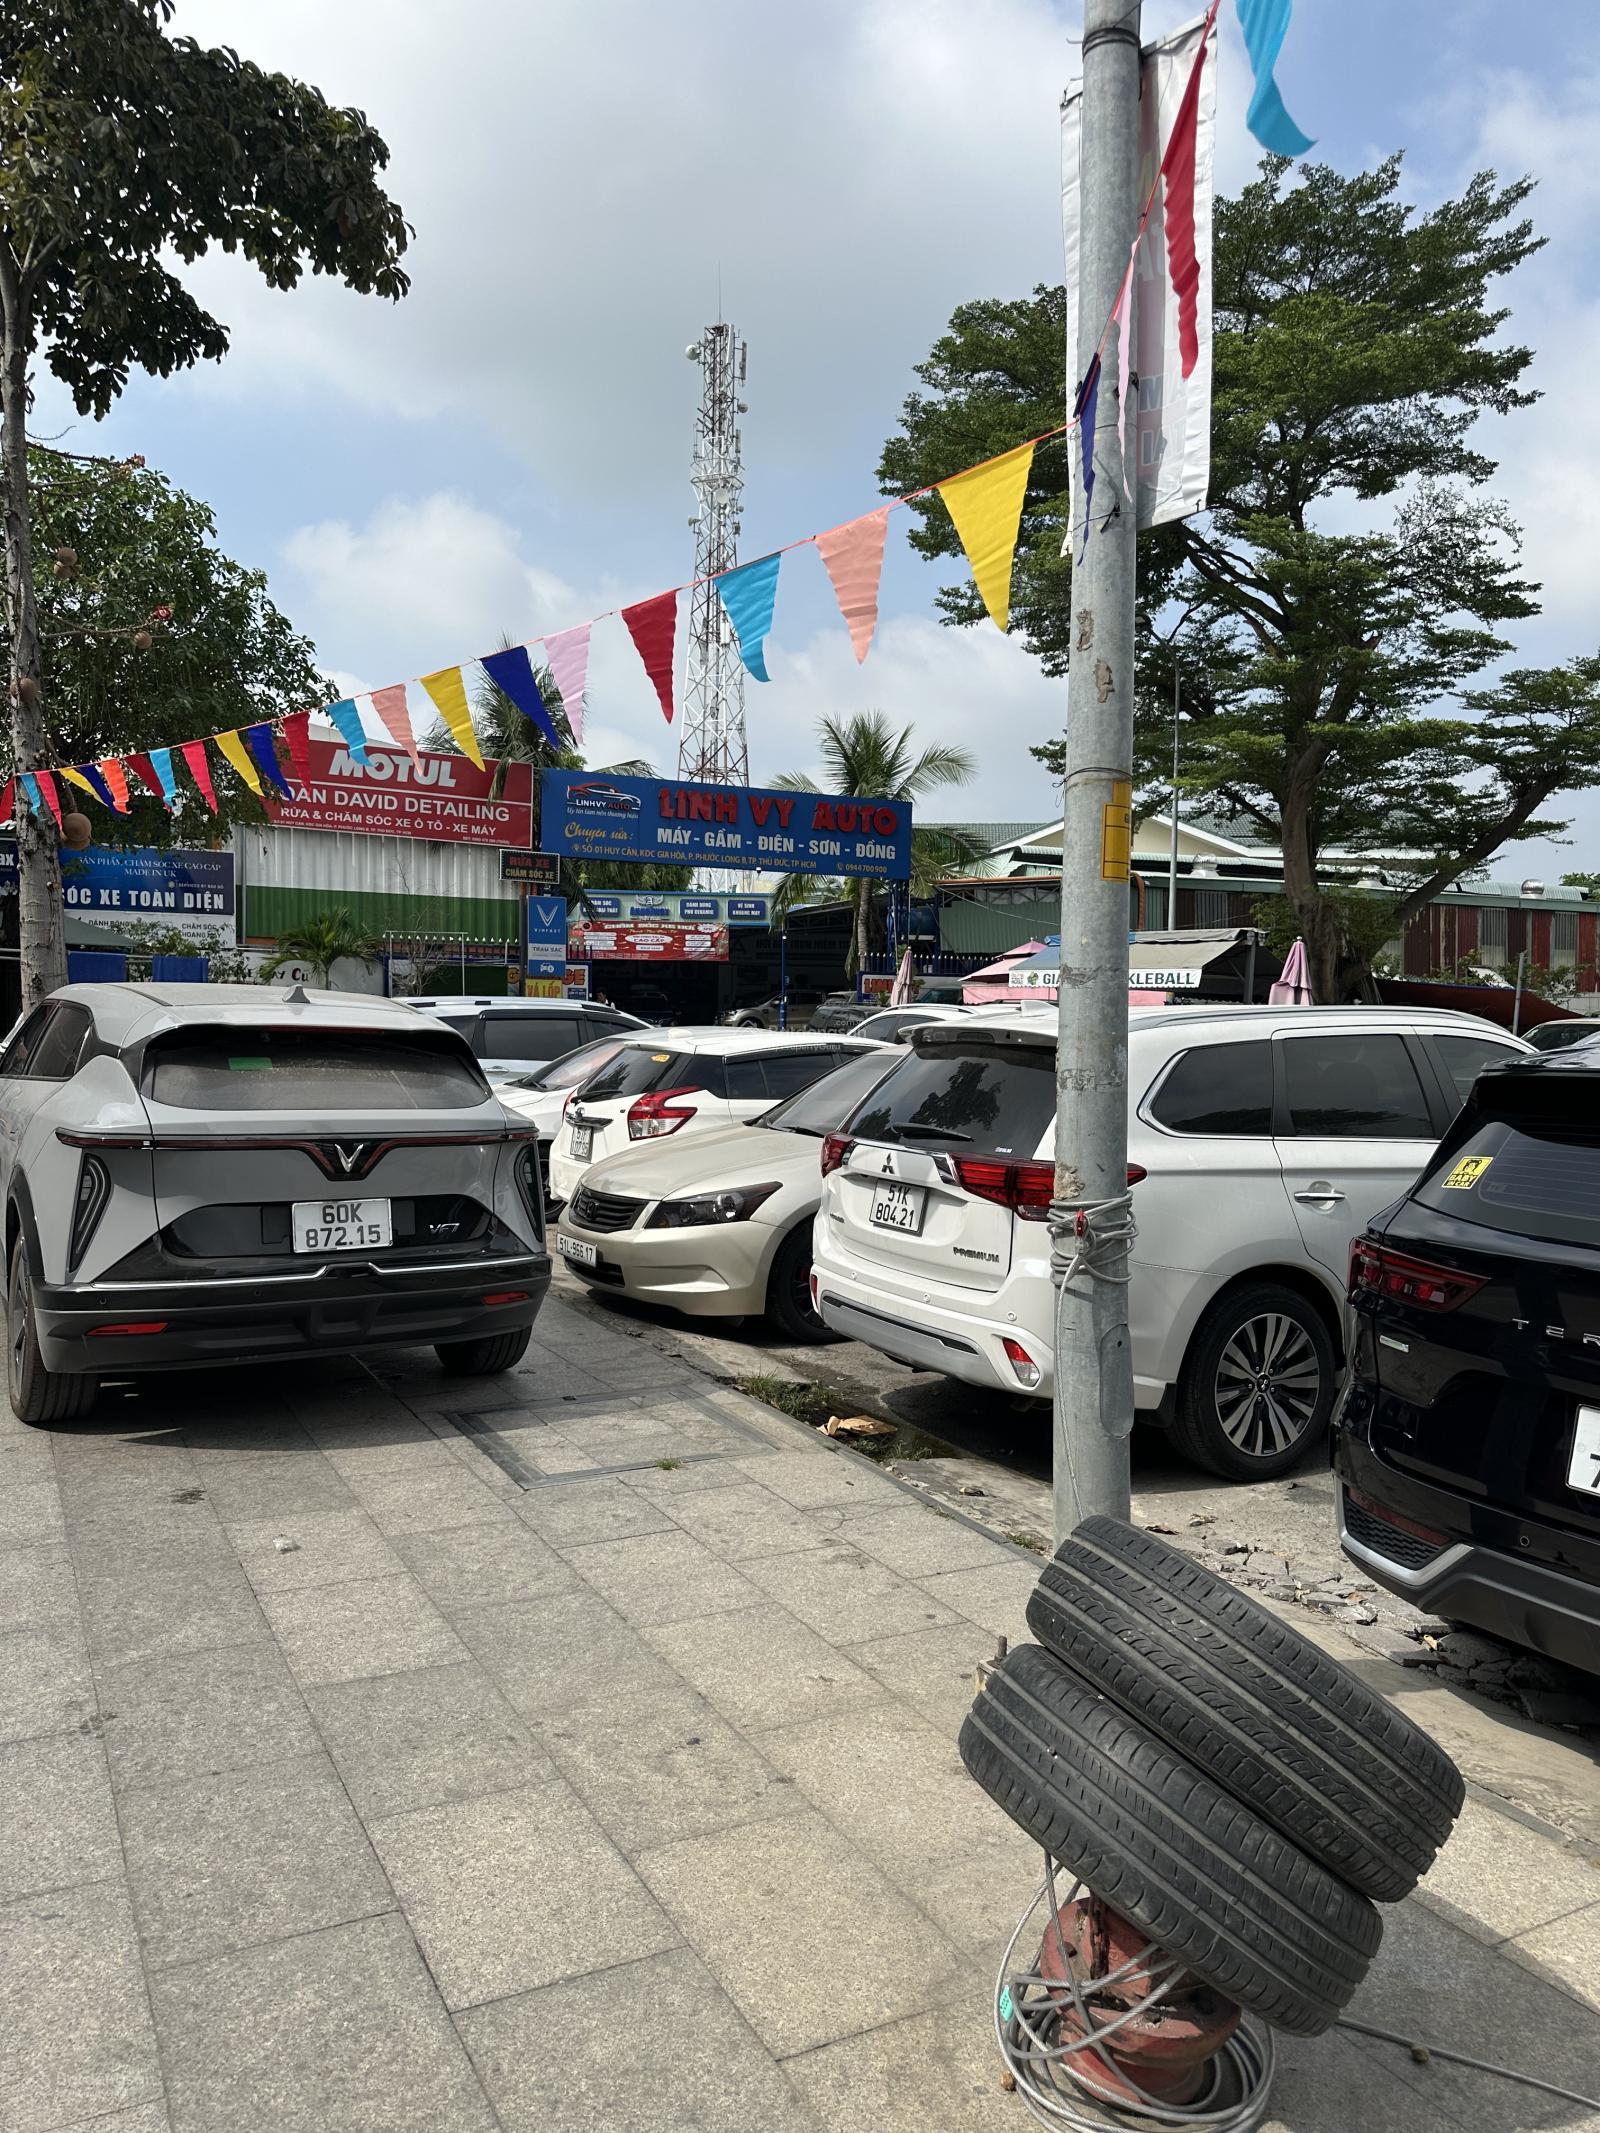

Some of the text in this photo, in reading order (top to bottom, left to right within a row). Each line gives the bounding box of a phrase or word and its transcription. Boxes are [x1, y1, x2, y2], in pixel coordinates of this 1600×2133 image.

[328, 748, 457, 788] MOTUL
[334, 790, 398, 811] DAVID
[404, 797, 510, 821] DETAILING
[658, 788, 897, 835] LINH VY AUTO
[280, 806, 310, 818] RỬA
[312, 810, 321, 820] &
[325, 811, 362, 823] CHĂM
[365, 813, 392, 826] SÓC
[395, 817, 411, 828] XE
[414, 817, 424, 829] Ô
[427, 820, 443, 831] TÔ
[453, 823, 468, 833] XE
[471, 823, 496, 836] MÁY
[564, 821, 606, 842] Chuyên
[657, 826, 692, 845] MÁY
[704, 828, 741, 849] GẦM
[758, 834, 794, 854] ĐIỆN
[808, 838, 840, 856] SƠN
[856, 839, 896, 860] ĐỒNG
[184, 862, 203, 870] CAO
[594, 845, 602, 854] 01
[604, 846, 620, 855] HUY
[640, 849, 655, 857] KDC
[657, 850, 669, 859] GIA
[721, 855, 741, 864] LONG
[801, 860, 817, 869] HCM
[124, 867, 177, 878] MADE IN UK
[545, 871, 555, 880] XE
[100, 889, 120, 905] XE
[129, 887, 175, 907] TOÀN
[184, 891, 224, 912] DIỆN
[1448, 1174, 1478, 1182] BABY
[887, 1183, 912, 1205] 51K
[322, 1202, 363, 1224] 60K
[875, 1203, 915, 1228] 804.21
[305, 1224, 381, 1248] 872.15
[953, 1246, 1000, 1263] PREMIUM
